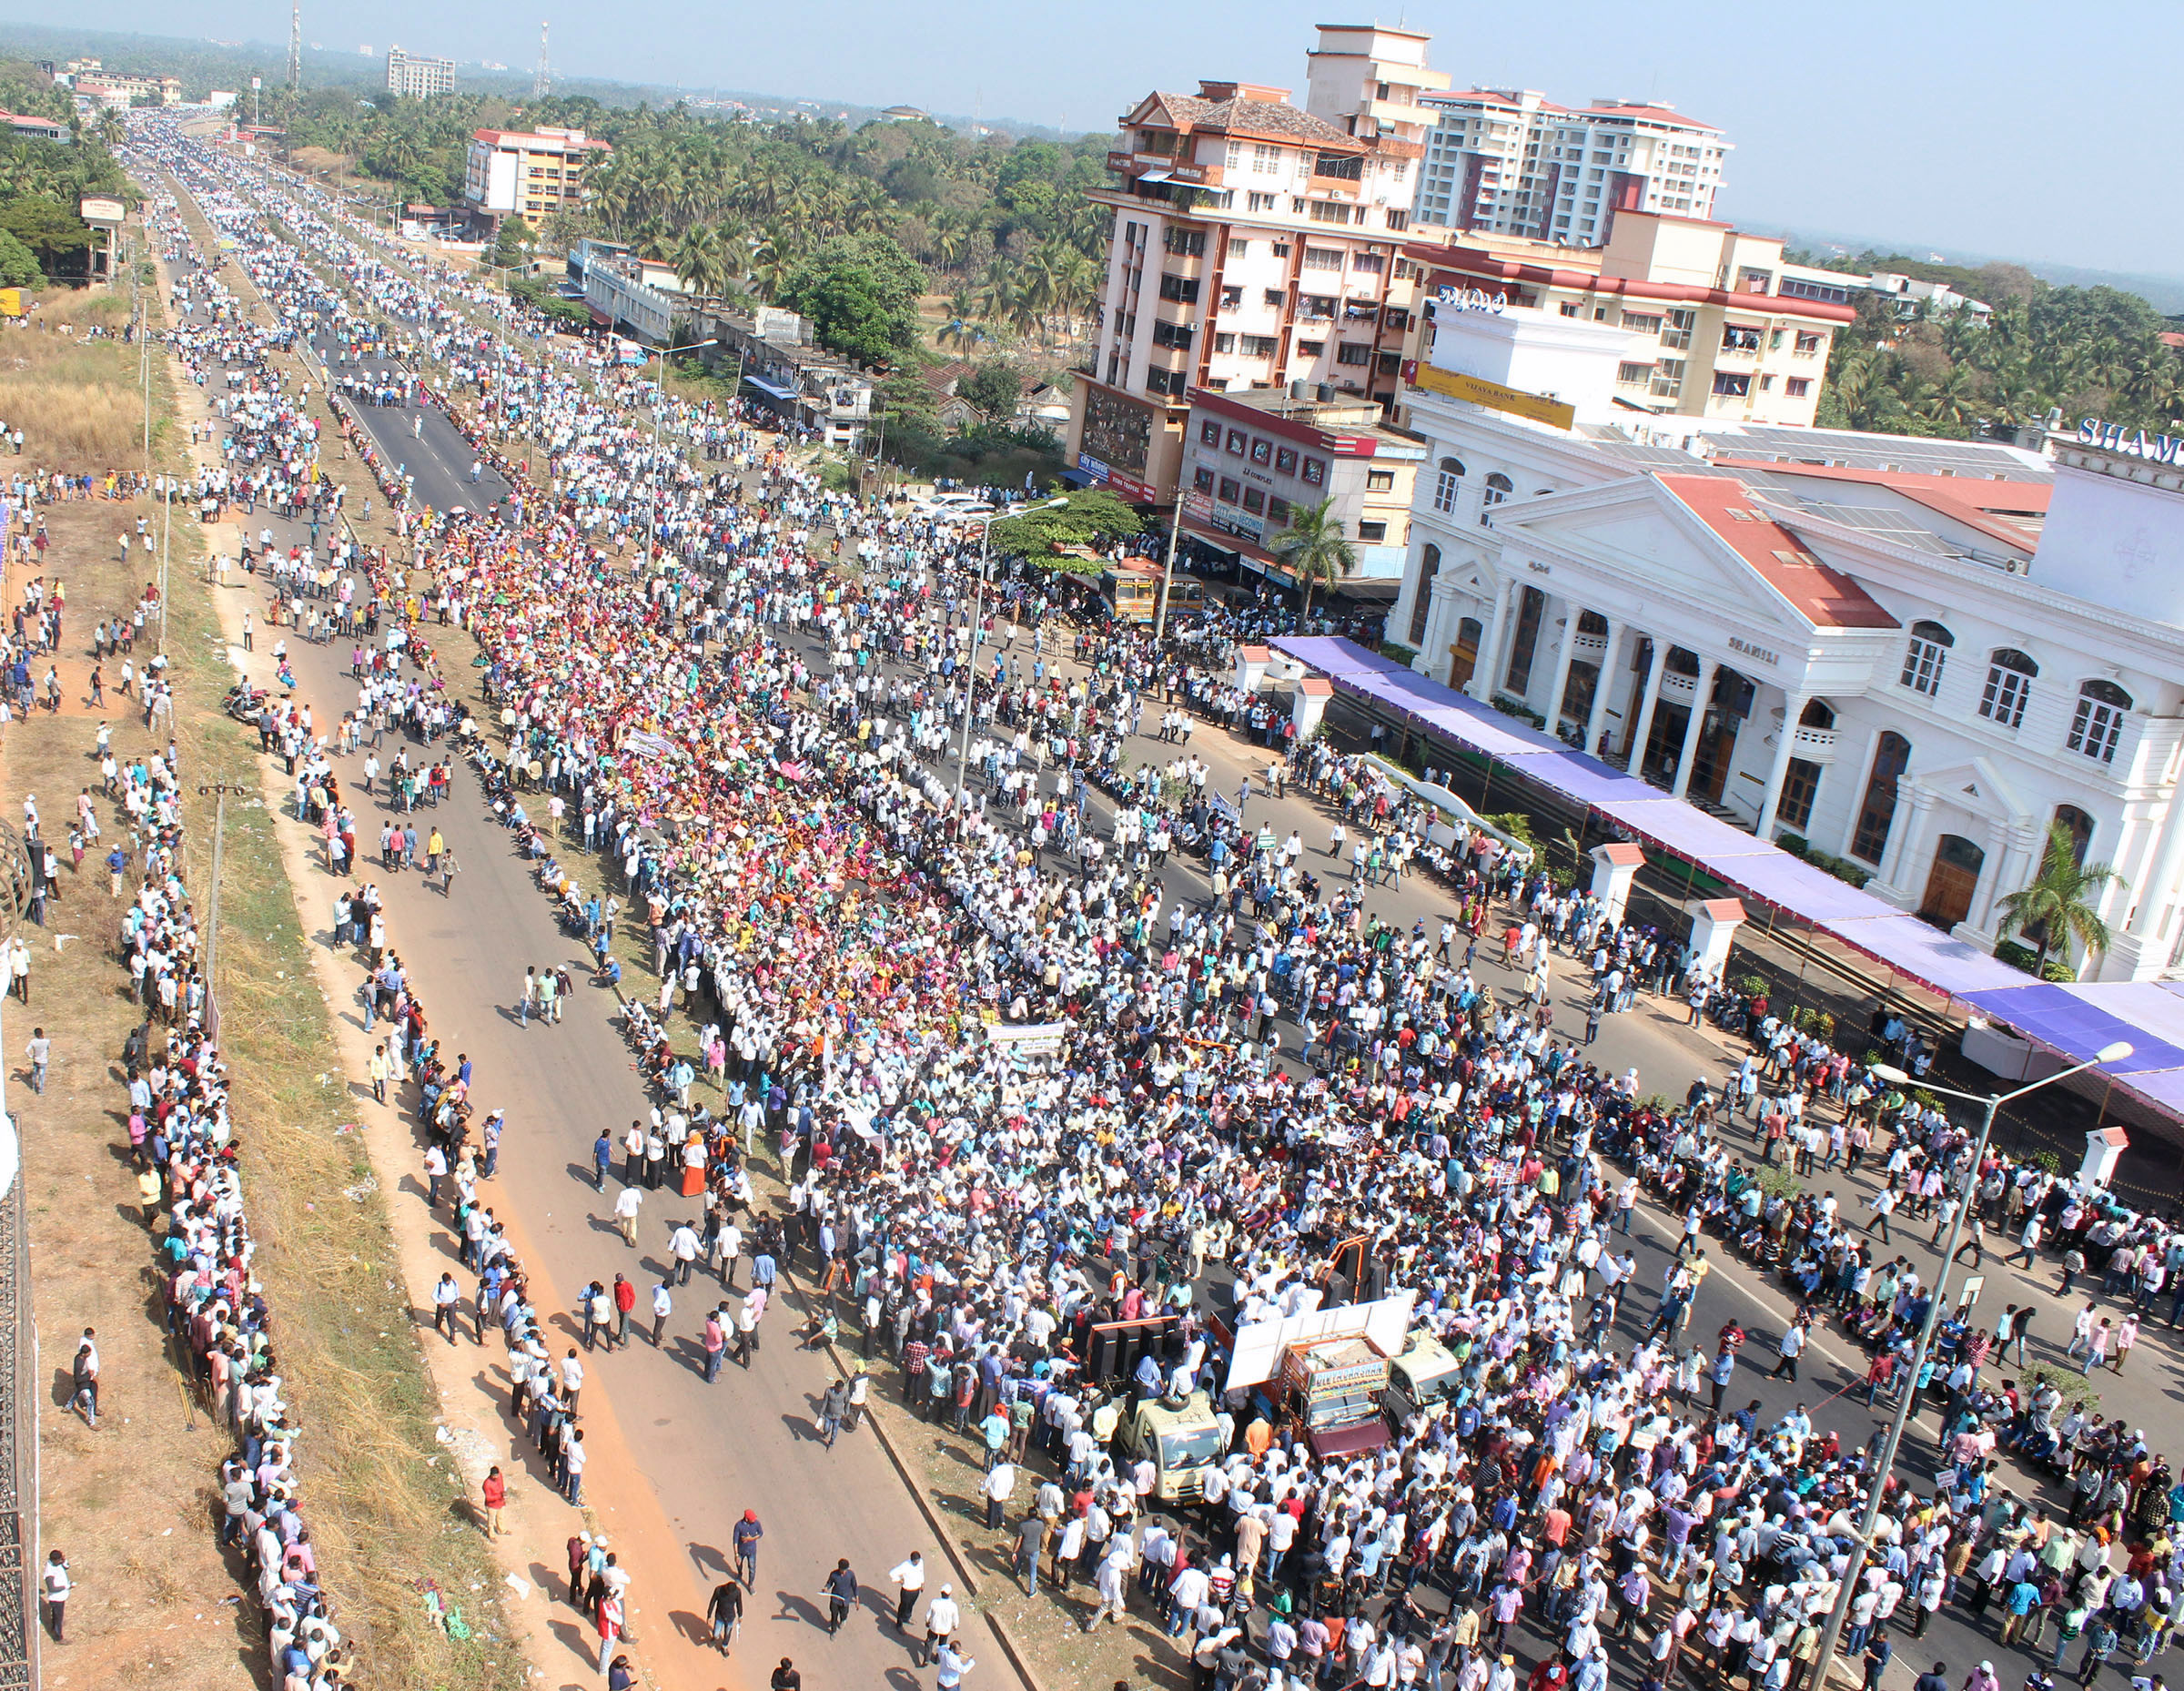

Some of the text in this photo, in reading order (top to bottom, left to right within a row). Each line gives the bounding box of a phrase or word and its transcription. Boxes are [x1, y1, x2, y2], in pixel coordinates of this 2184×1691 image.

[1466, 381, 1491, 395] VIJAYA
[1493, 389, 1515, 401] BANK
[1250, 471, 1272, 485] COMPLEX
[1729, 637, 1779, 665] SHAMILI
